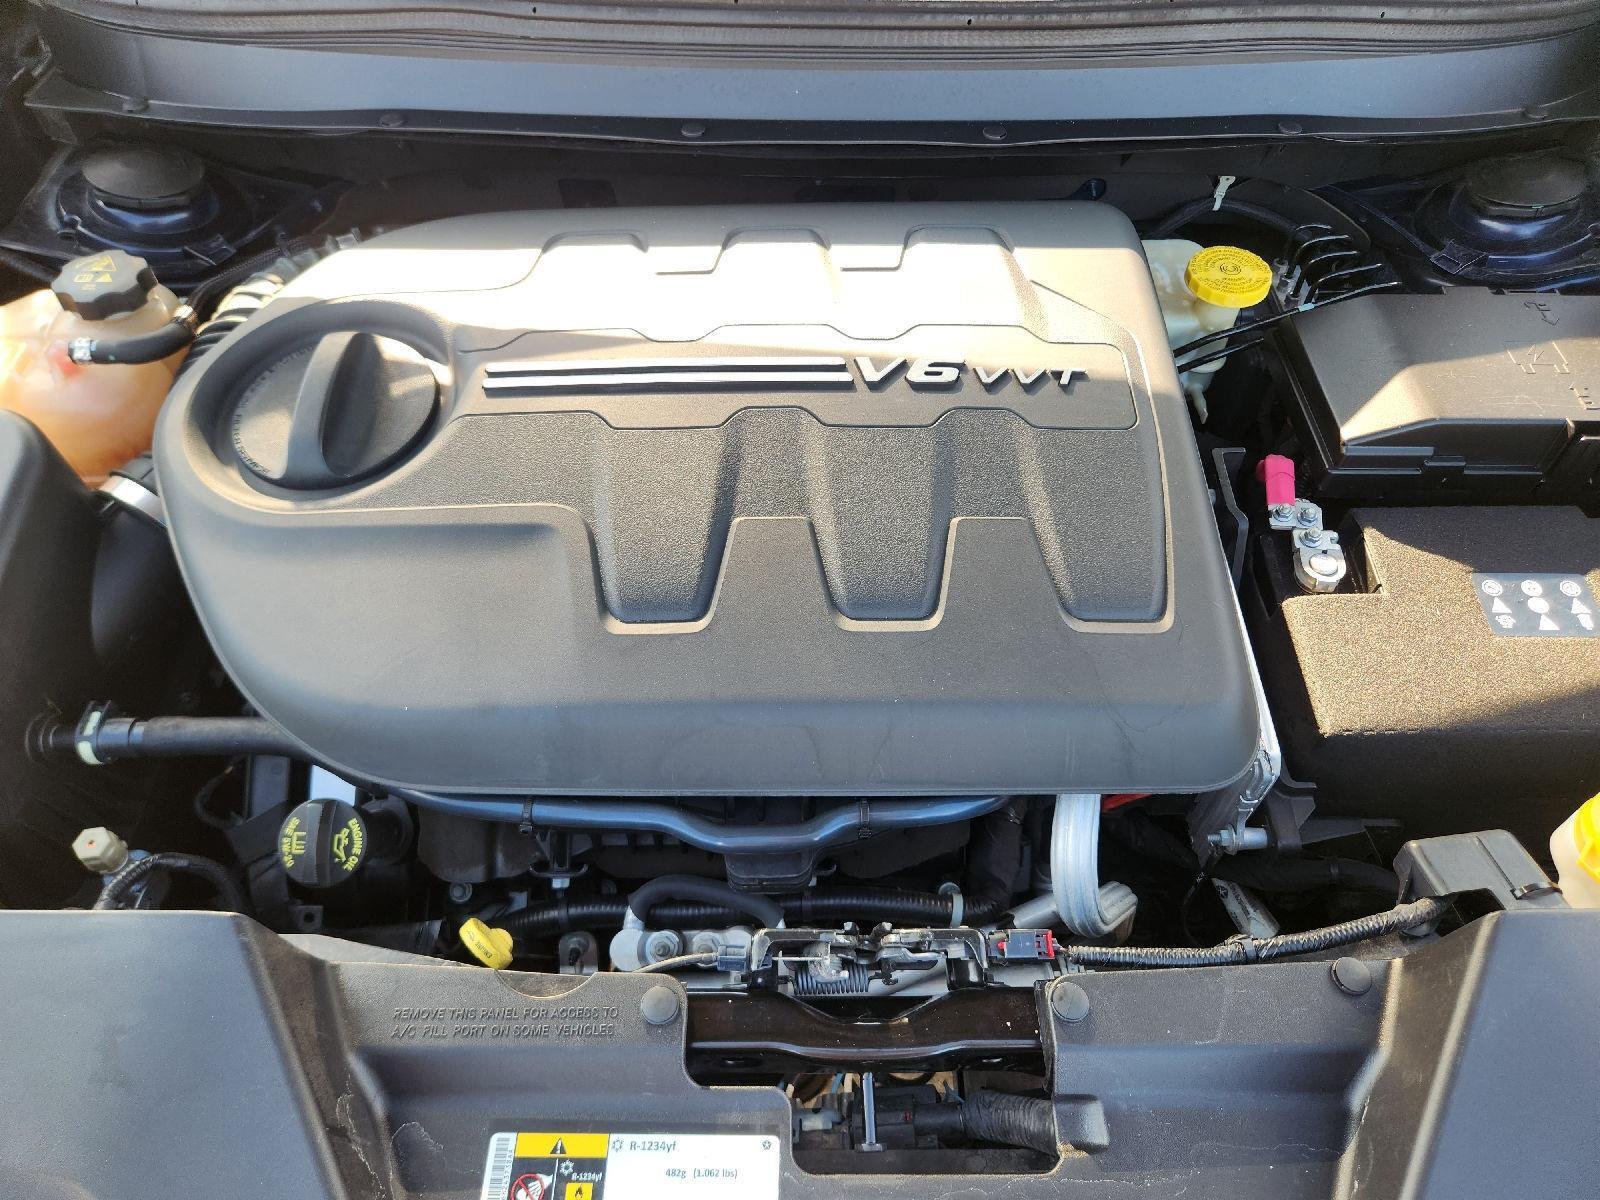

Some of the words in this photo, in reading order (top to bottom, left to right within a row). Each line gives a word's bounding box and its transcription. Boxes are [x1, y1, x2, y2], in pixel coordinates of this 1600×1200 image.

[854, 356, 966, 388] V6
[973, 367, 1087, 387] VVT
[284, 817, 301, 837] SAE
[348, 818, 362, 855] ENGINE
[343, 856, 358, 871] OIL
[393, 1007, 446, 1020] REMOVE
[449, 1007, 477, 1020] THIS
[480, 1007, 520, 1019] PANEL
[523, 1007, 549, 1019] FOR
[550, 1006, 600, 1019] ACCESS
[602, 1006, 619, 1018] TO
[391, 1024, 417, 1039] A/C
[422, 1024, 449, 1038] FILL
[453, 1024, 487, 1037] PORT
[491, 1024, 511, 1037] ON
[513, 1024, 551, 1037] SOME
[554, 1023, 615, 1037] VEHICLES
[629, 1140, 677, 1153] R-1234yf
[665, 1168, 687, 1179] 482g
[693, 1168, 720, 1179] (1.062
[722, 1168, 738, 1179] lbs)
